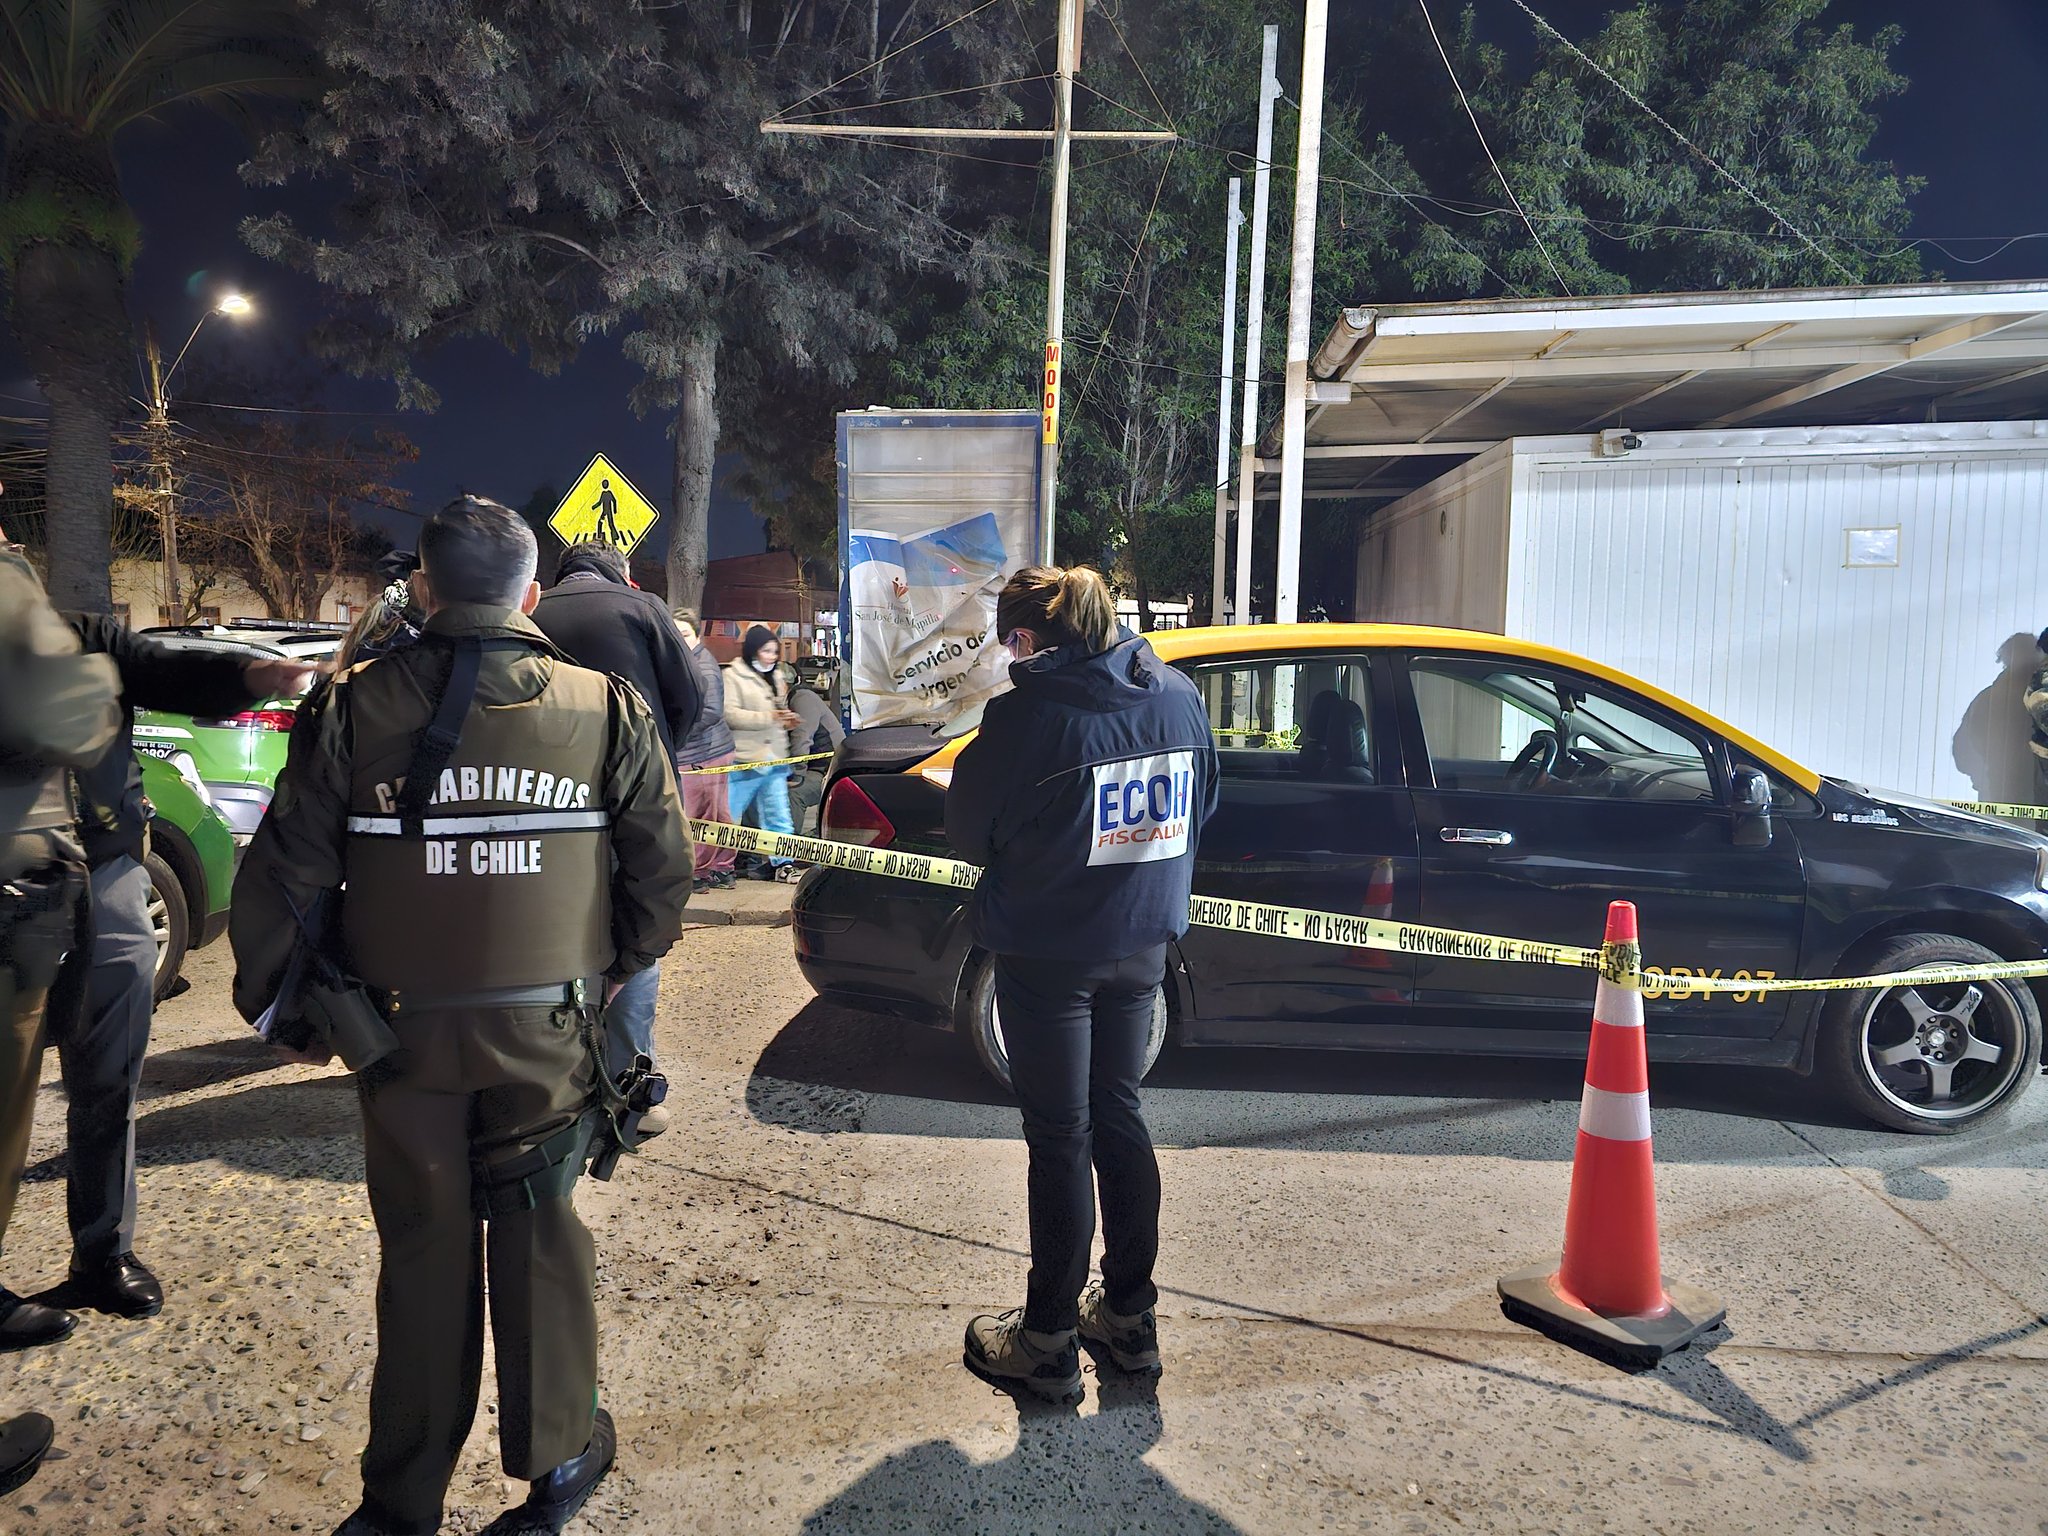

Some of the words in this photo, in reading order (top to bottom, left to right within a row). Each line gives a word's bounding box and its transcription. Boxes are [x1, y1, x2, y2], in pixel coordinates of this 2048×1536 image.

[1045, 345, 1059, 432] M001
[855, 610, 871, 621] San
[872, 610, 892, 623] José
[893, 643, 962, 685] Servicio
[375, 766, 590, 814] CABINEROS
[1099, 771, 1189, 832] ECOH
[1832, 812, 1849, 823] LOS
[1985, 804, 1997, 815] NO
[2009, 806, 2035, 819] CHILE
[1098, 822, 1184, 848] FISCALIA
[425, 841, 457, 874] DE
[470, 840, 542, 875] CHILE
